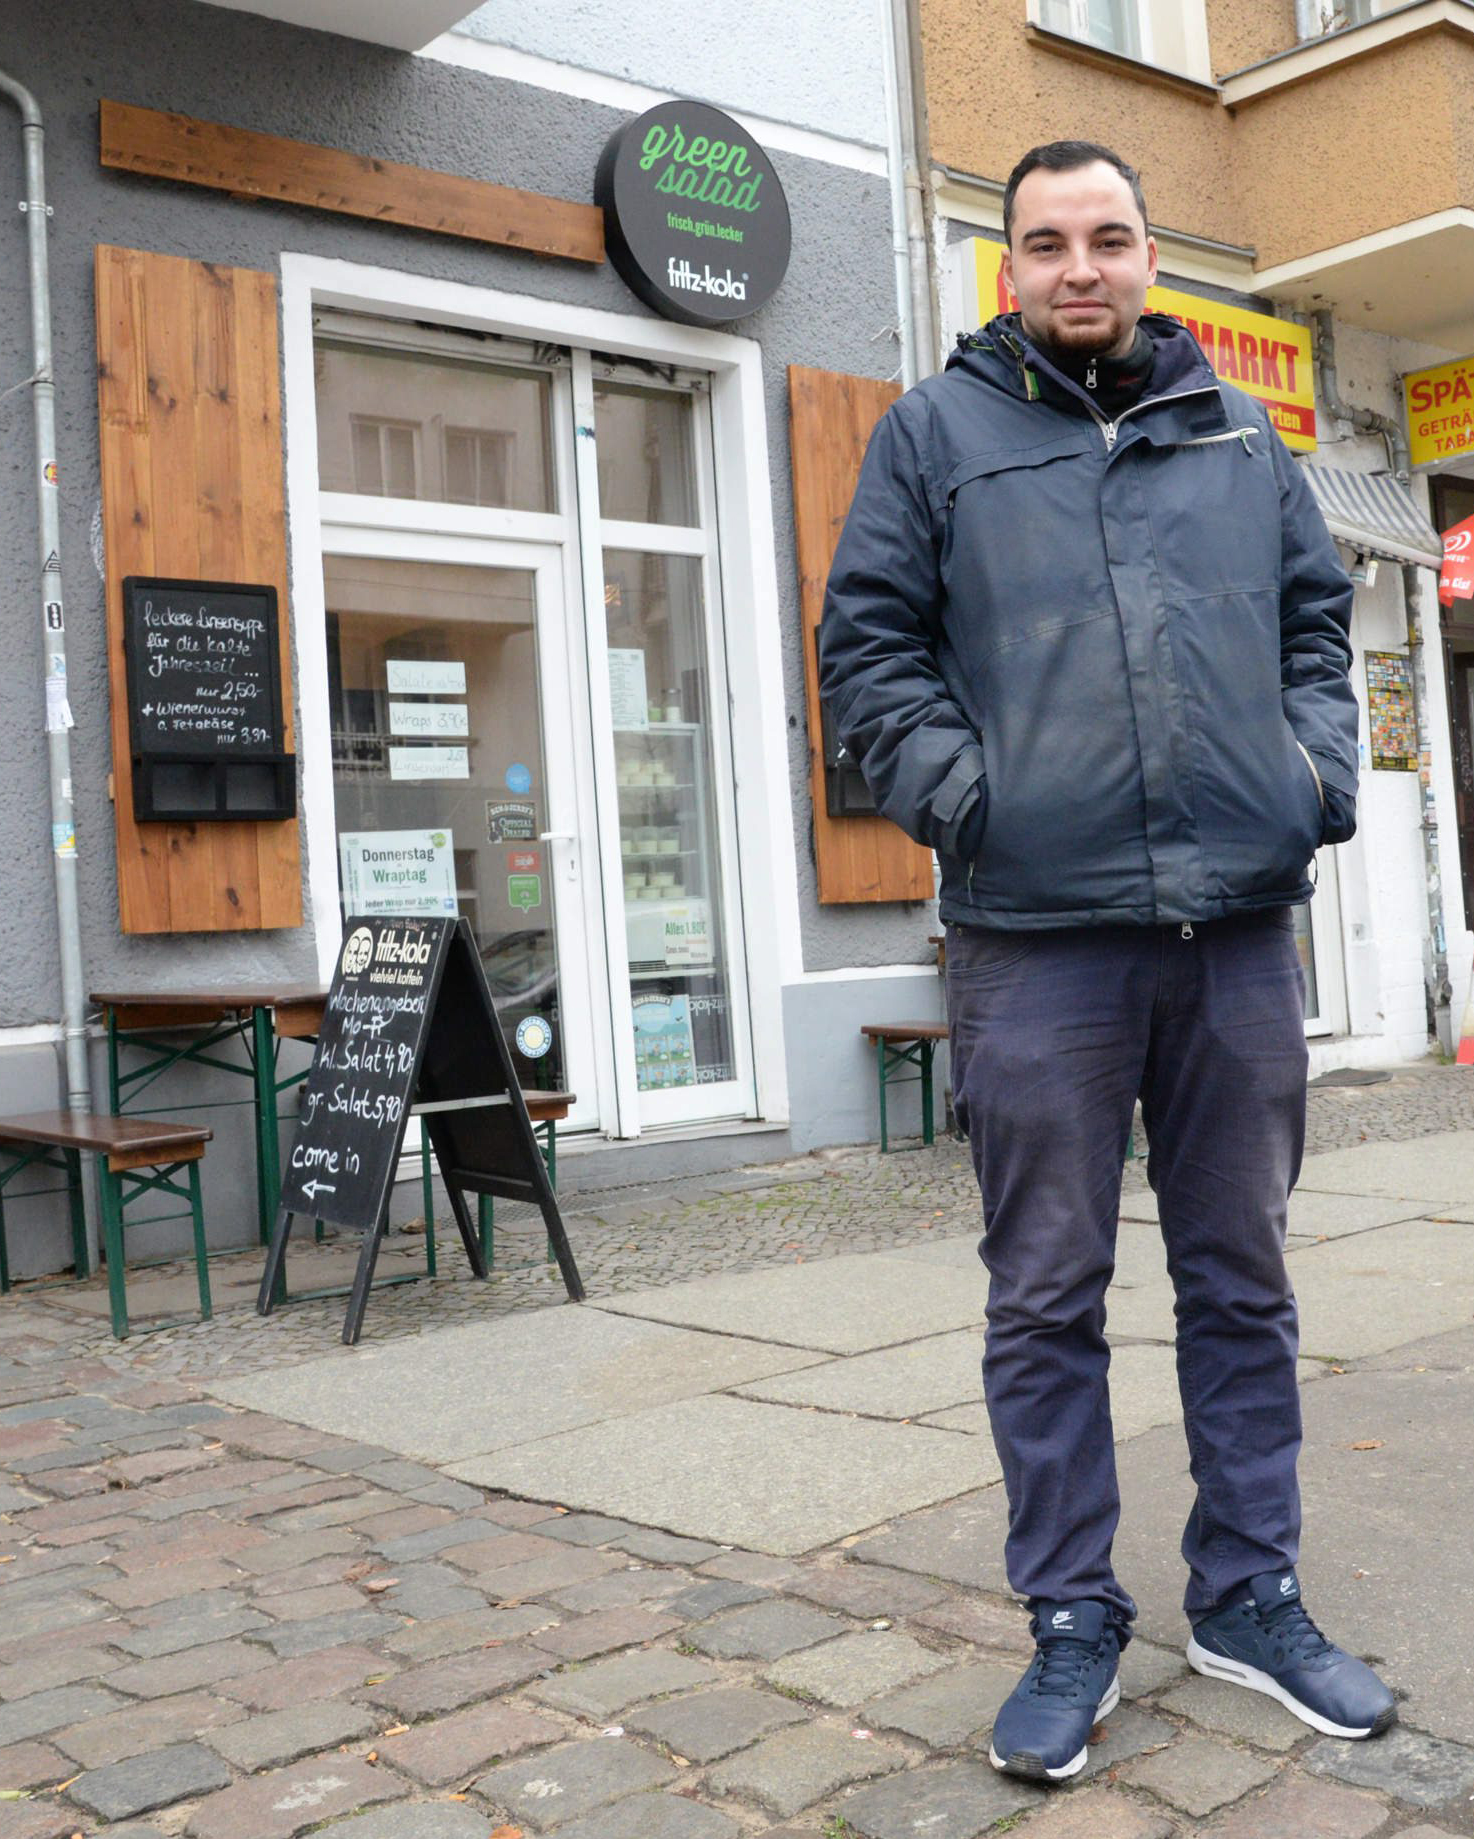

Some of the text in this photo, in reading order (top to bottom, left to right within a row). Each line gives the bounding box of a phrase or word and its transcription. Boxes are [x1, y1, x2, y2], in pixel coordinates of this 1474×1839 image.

[639, 123, 752, 177] green
[655, 163, 763, 213] salad
[667, 256, 746, 300] fritz-kola
[1268, 407, 1301, 430] rten
[1418, 408, 1474, 437] GETRÄ
[144, 601, 266, 640] leckere Linsensuppe
[146, 632, 170, 653] für
[176, 635, 201, 652] die
[195, 686, 220, 697] nur
[392, 711, 433, 733] Wraps
[216, 734, 237, 745] nur
[362, 847, 435, 863] Donnerstag
[372, 868, 427, 885] Wraptag
[665, 921, 685, 936] Alles
[374, 928, 432, 964] fritz-kola
[369, 967, 424, 986] vielviel koffein
[336, 1040, 381, 1072] Salat
[328, 1083, 371, 1118] Salat
[345, 1146, 360, 1175] in
